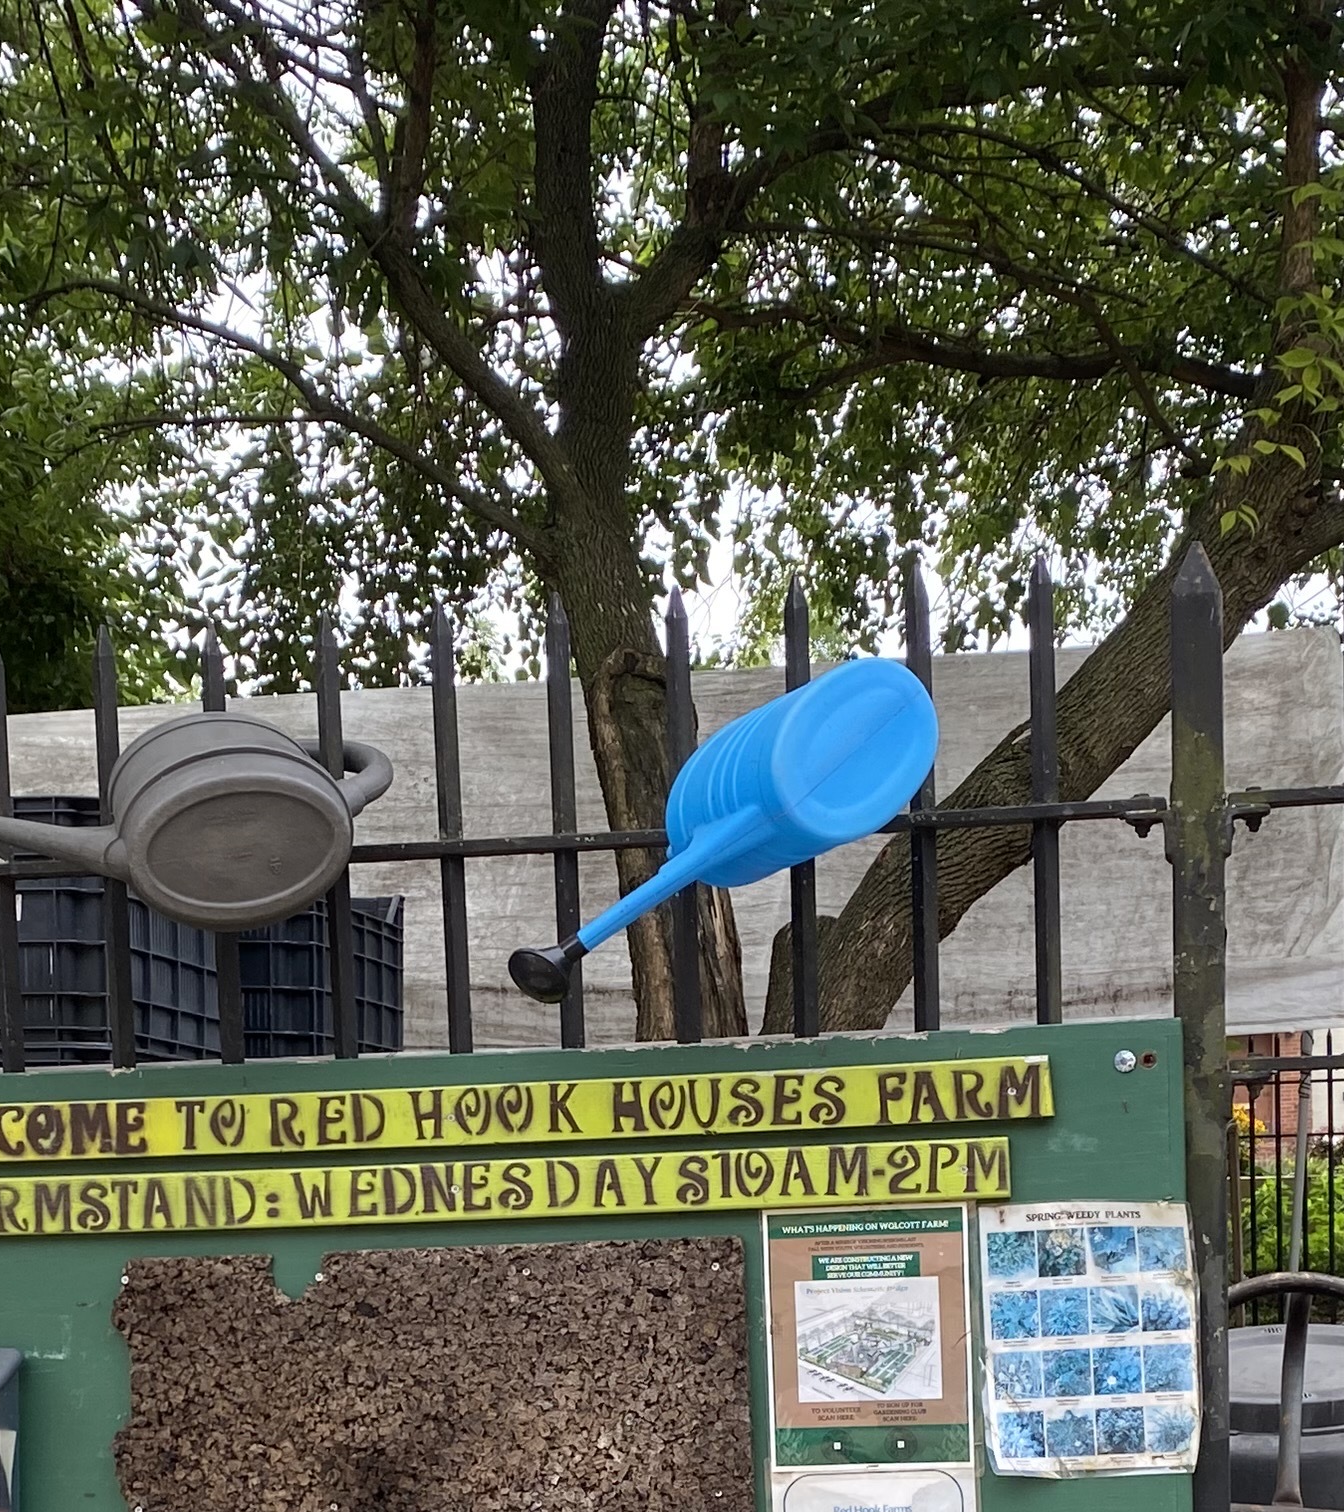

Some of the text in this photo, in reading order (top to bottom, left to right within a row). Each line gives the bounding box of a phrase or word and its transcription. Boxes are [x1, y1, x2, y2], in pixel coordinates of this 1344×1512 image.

[175, 1099, 245, 1150] TO
[269, 1092, 386, 1147] RED
[414, 1081, 584, 1142] HOOK
[612, 1073, 846, 1134] HOUSES
[877, 1063, 1048, 1124] FARM
[291, 1154, 710, 1219] WEDNESDAYS
[712, 1140, 1009, 1199] 10AM-2PM
[782, 1224, 815, 1234] WHAT'S
[816, 1223, 864, 1233] HAPPENING
[865, 1222, 878, 1231] ON
[880, 1221, 921, 1231] WOLCOTT
[1026, 1212, 1062, 1222] SPRING
[1066, 1211, 1101, 1220] WEEDY
[1105, 1210, 1141, 1219] PLANTS
